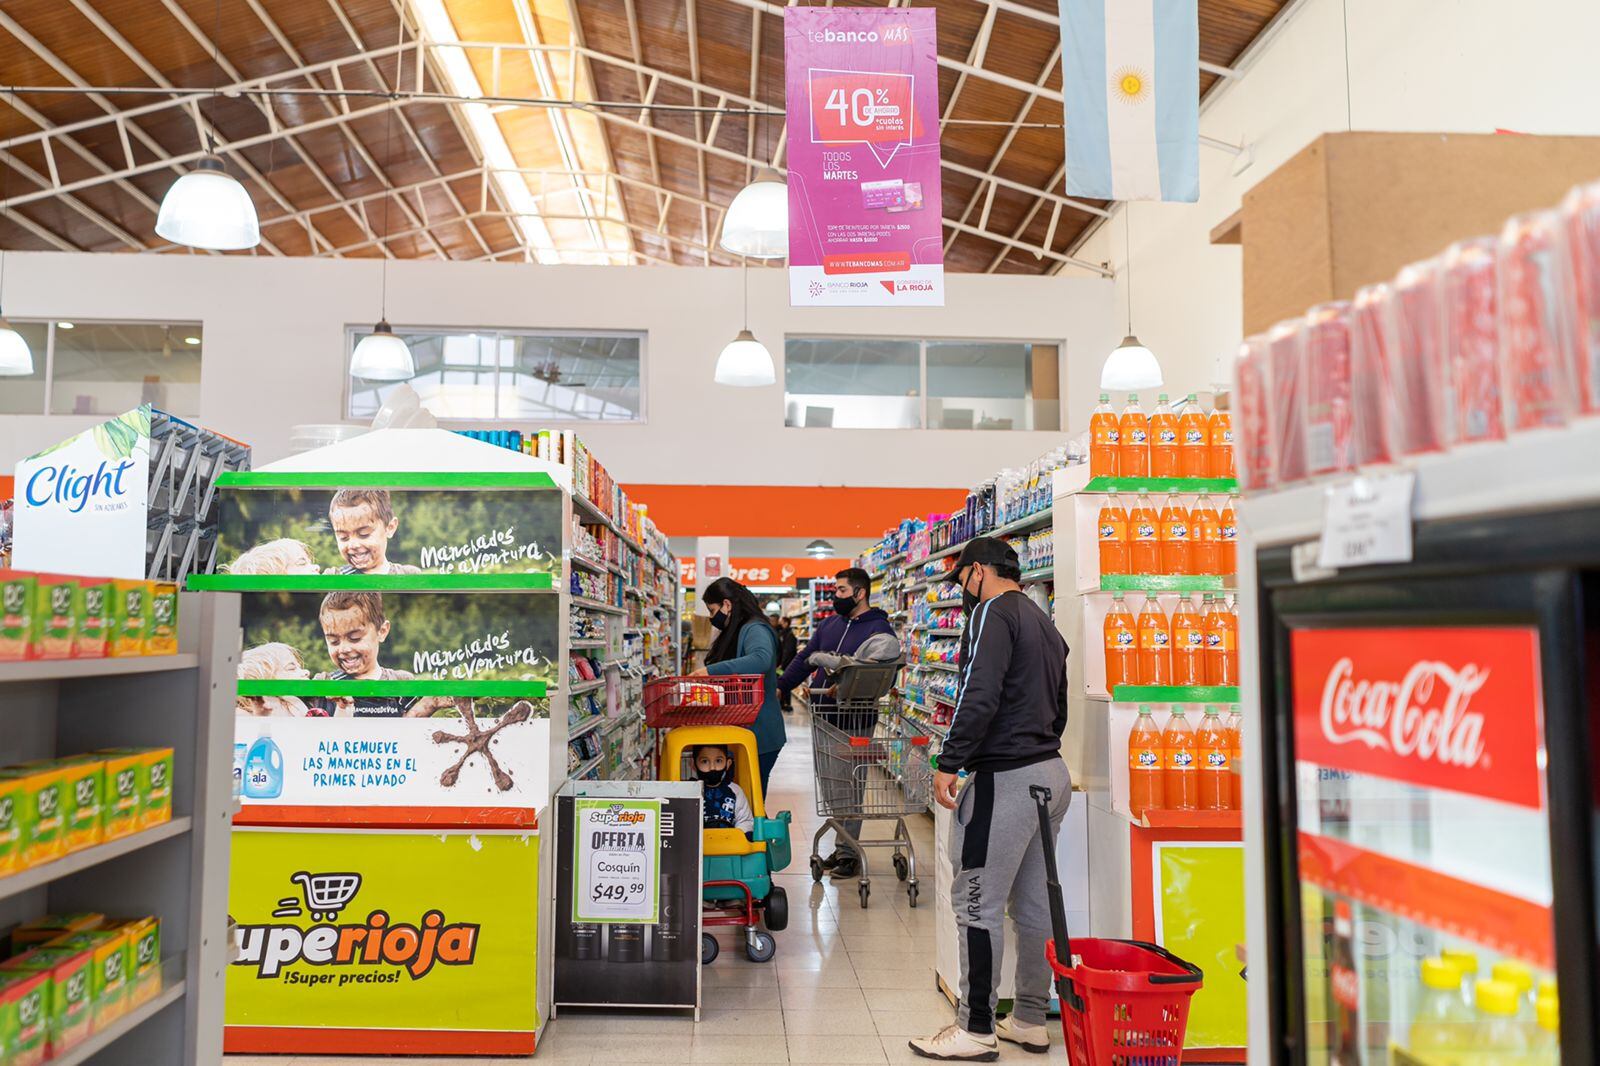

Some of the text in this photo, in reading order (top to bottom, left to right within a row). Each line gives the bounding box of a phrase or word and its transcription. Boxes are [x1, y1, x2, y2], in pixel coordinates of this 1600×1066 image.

[808, 28, 879, 43] tebanco
[822, 151, 852, 161] TODOS
[823, 161, 840, 171] LOS
[823, 170, 859, 180] MARTES
[909, 283, 934, 291] RIOJA
[26, 460, 136, 513] Clight
[421, 526, 515, 568] Manchados
[439, 541, 543, 574] de aventura
[680, 563, 770, 581] Fibres
[413, 630, 510, 674] Manchados
[432, 645, 540, 680] de aventura
[318, 740, 399, 755] ALA REMUEVE
[303, 757, 417, 772] LAS MANCHAS EN EL
[252, 772, 267, 783] ala
[313, 773, 407, 788] PRIMER LAVADO
[589, 811, 646, 824] Superioja
[597, 861, 640, 874] Cosquín
[230, 909, 481, 980] uperioja
[284, 969, 402, 987] !Super precios!
